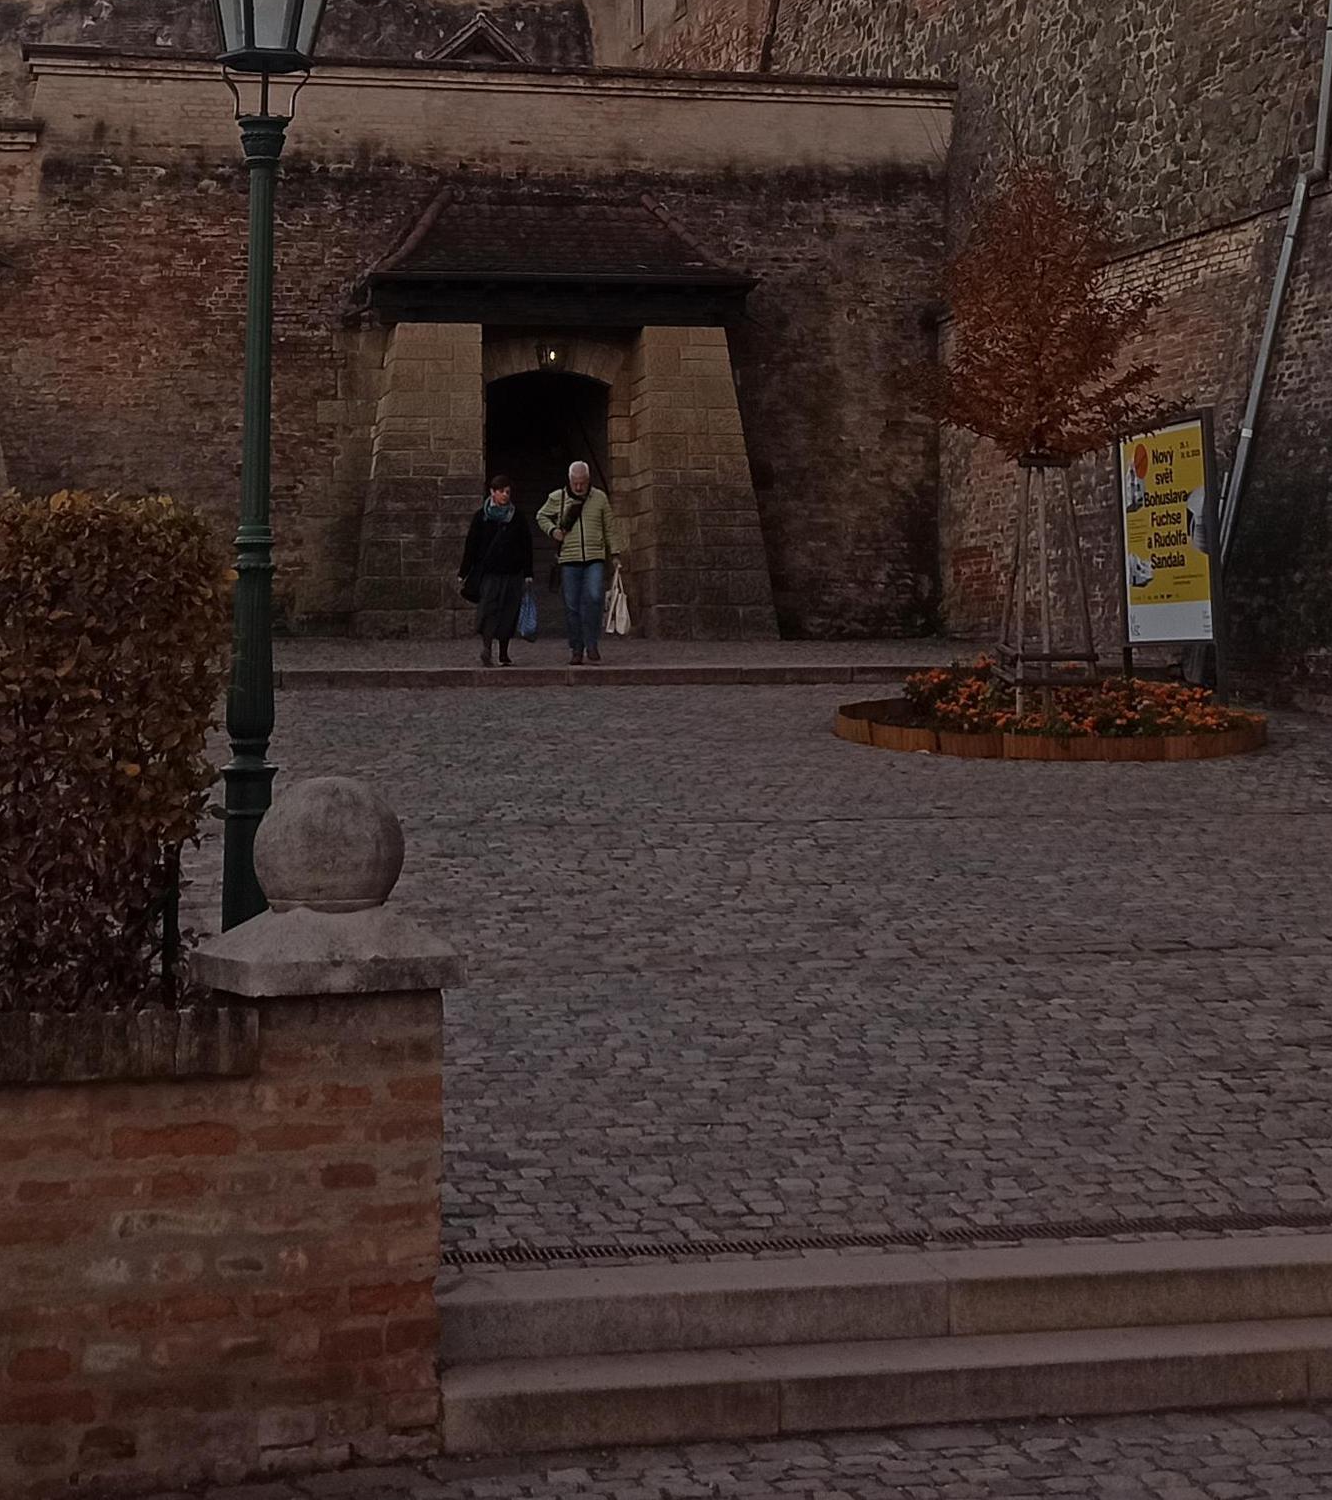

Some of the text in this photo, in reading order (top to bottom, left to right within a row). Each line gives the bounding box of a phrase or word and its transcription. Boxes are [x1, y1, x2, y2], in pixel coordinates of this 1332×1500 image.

[1152, 446, 1174, 466] Nový
[1155, 468, 1174, 485] svět
[1144, 489, 1188, 508] Bohuslava
[1151, 510, 1182, 528] Fuchse
[1147, 536, 1153, 549] a
[1154, 529, 1188, 549] Rudolfa
[1150, 552, 1185, 570] Sandala
